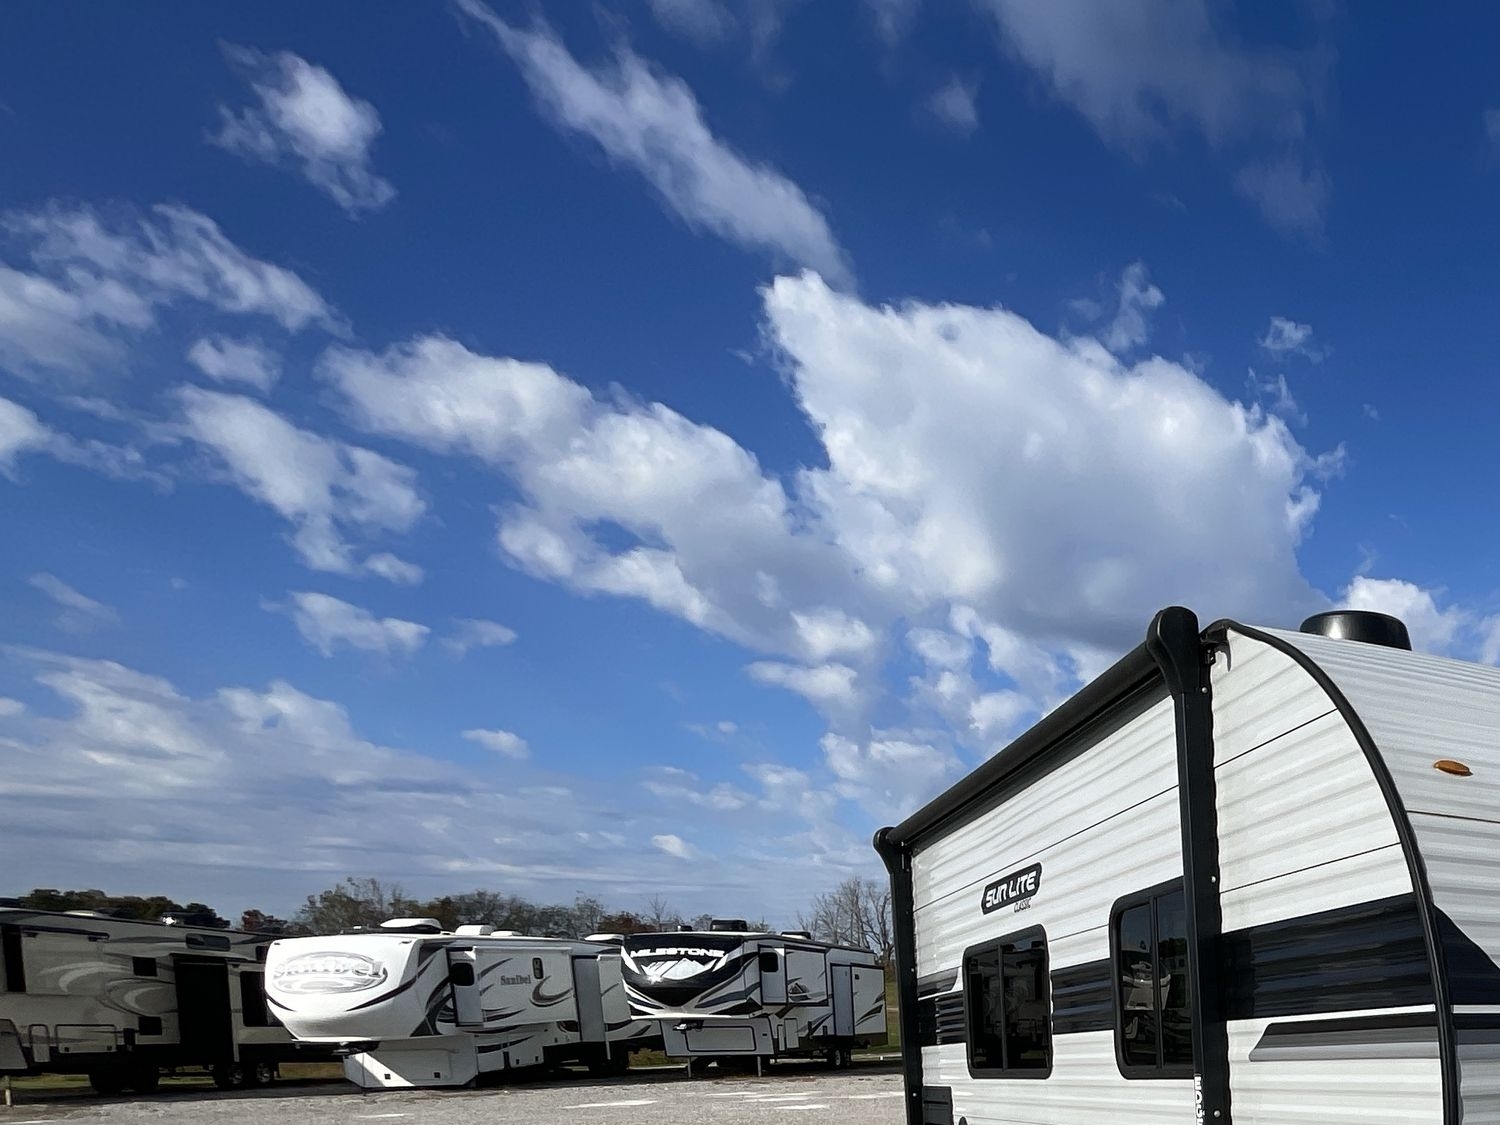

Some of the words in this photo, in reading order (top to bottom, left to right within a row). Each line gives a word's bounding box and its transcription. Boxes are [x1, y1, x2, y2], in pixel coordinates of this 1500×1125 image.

[985, 883, 1008, 908] SUN
[1008, 870, 1037, 898] LITE
[630, 947, 725, 958] MILESTONE
